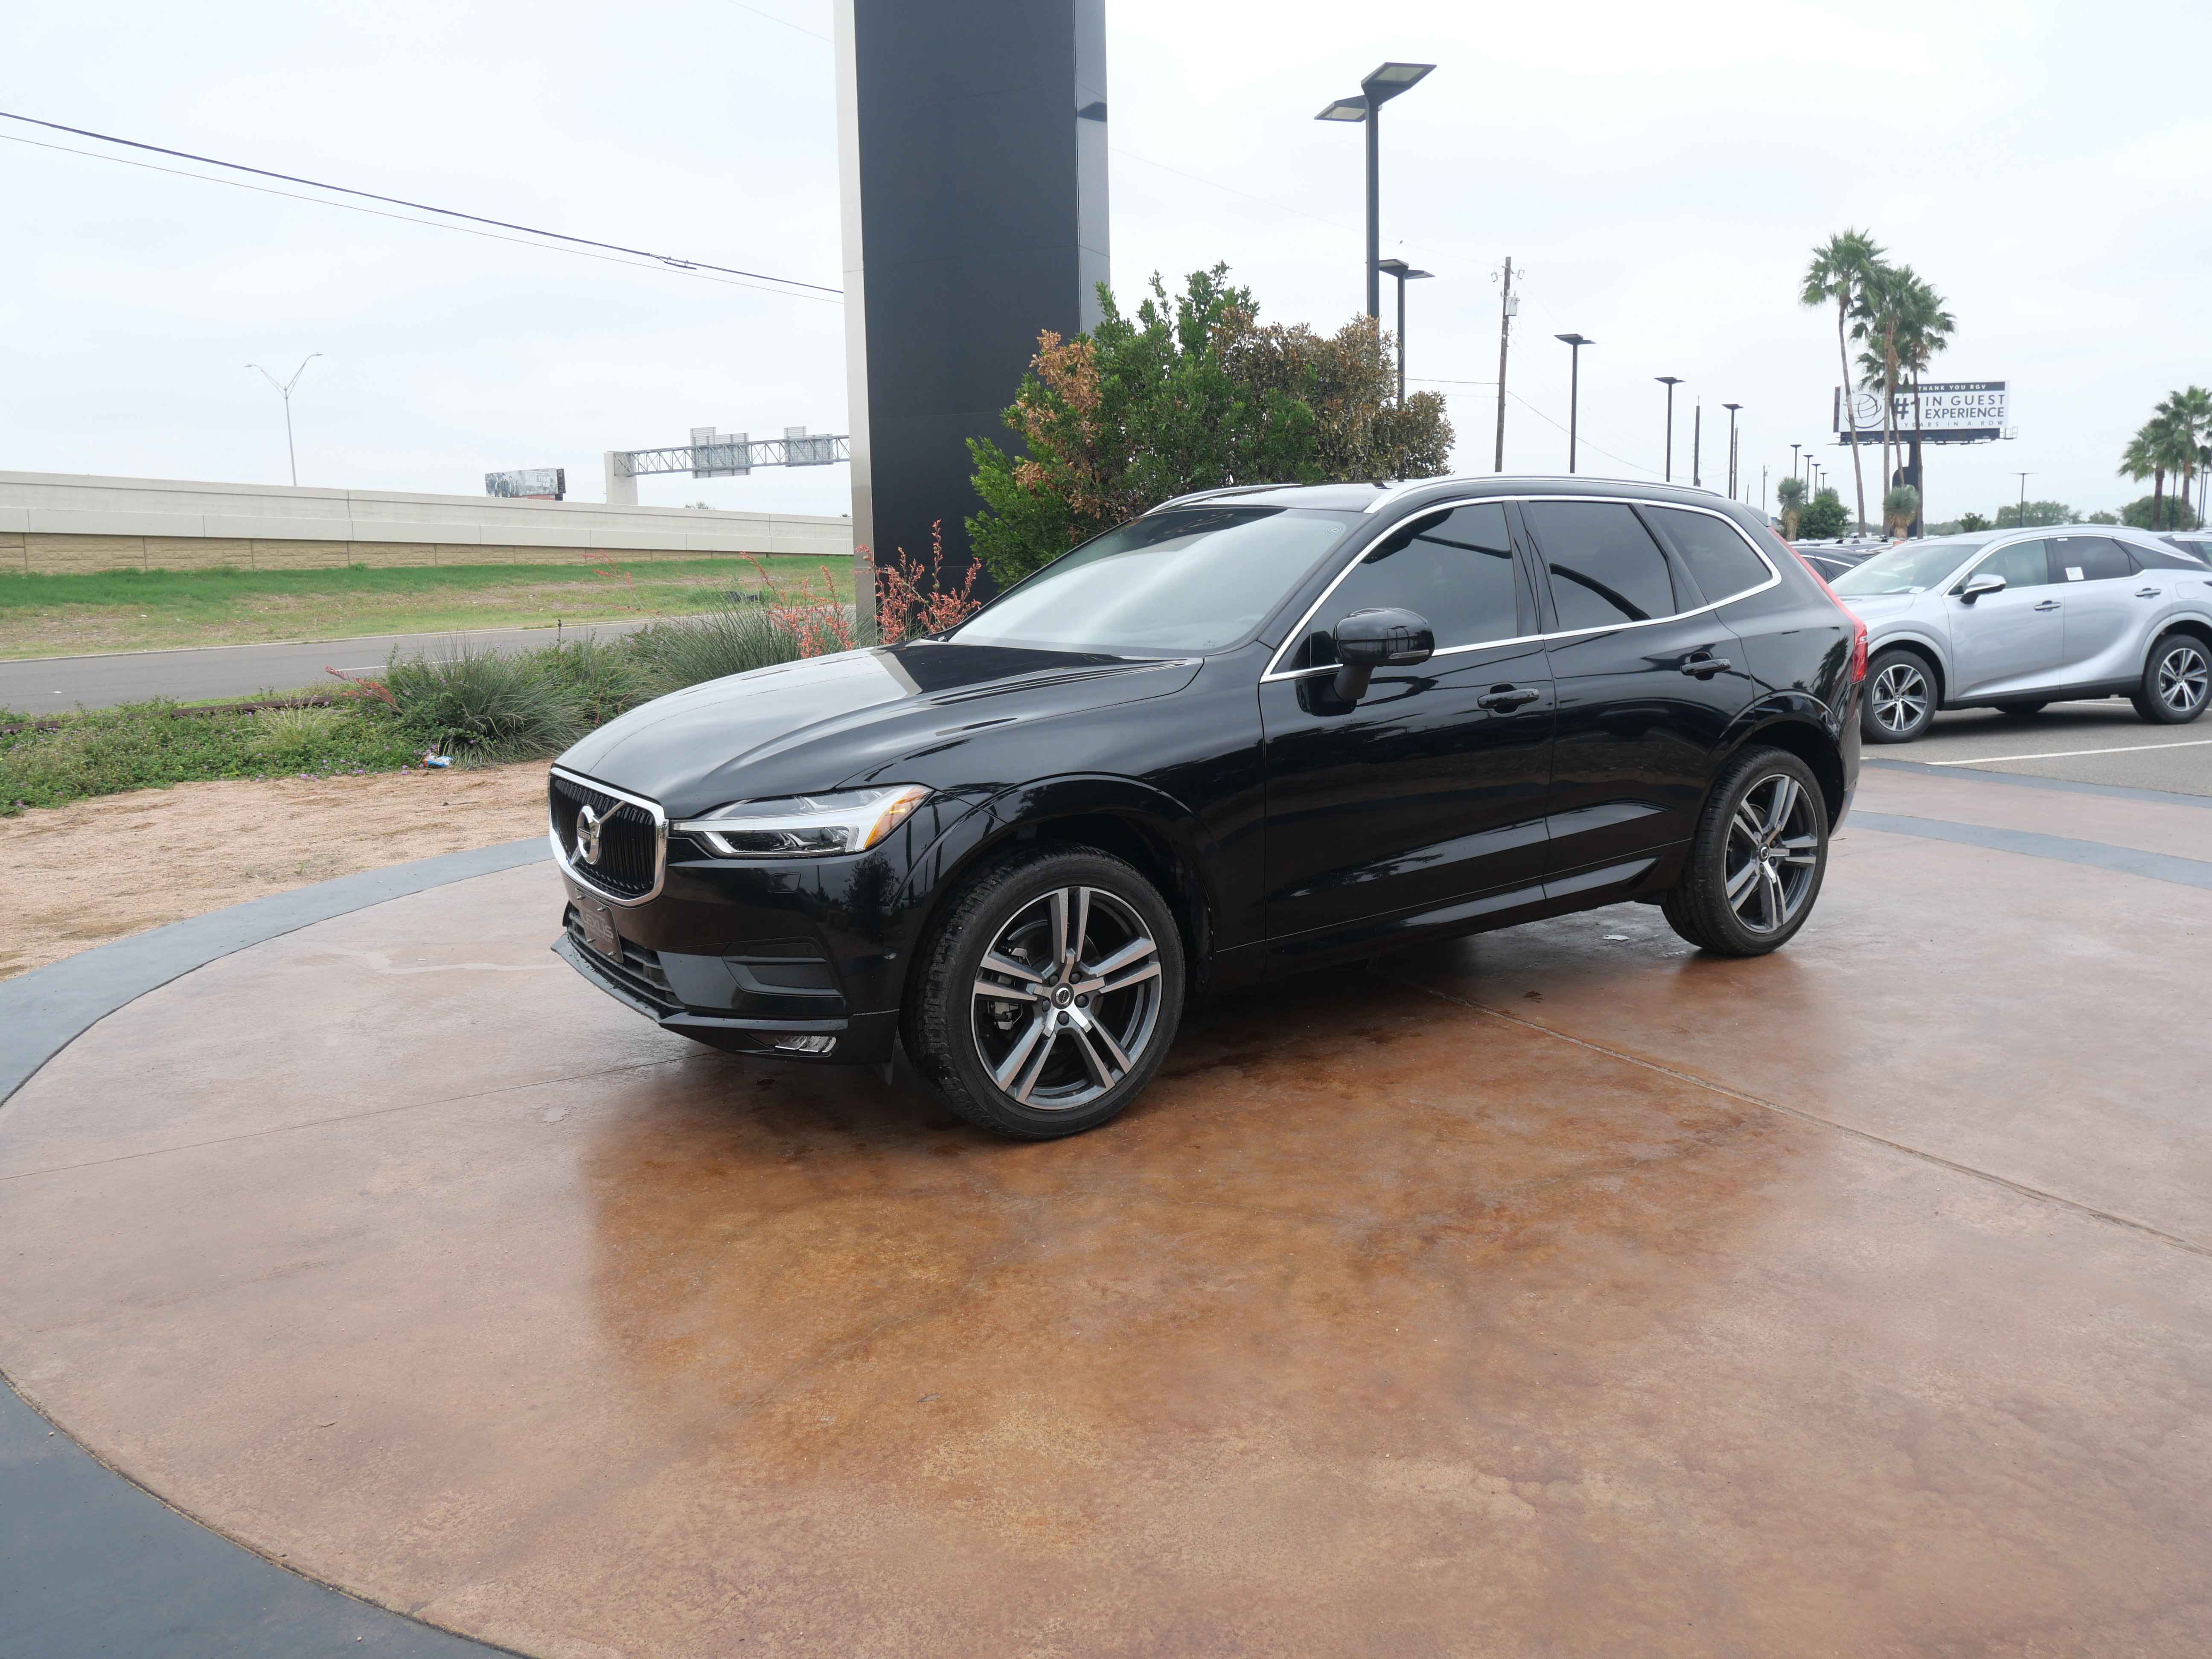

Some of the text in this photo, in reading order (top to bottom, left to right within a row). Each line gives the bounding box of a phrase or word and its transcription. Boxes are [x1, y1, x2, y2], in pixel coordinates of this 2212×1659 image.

[1926, 396, 1942, 406] IN
[1951, 395, 2005, 405] GUEST
[1925, 407, 2004, 419] EXPERIENCE
[578, 829, 590, 840] VOLVO
[581, 910, 614, 939] LEXUS
